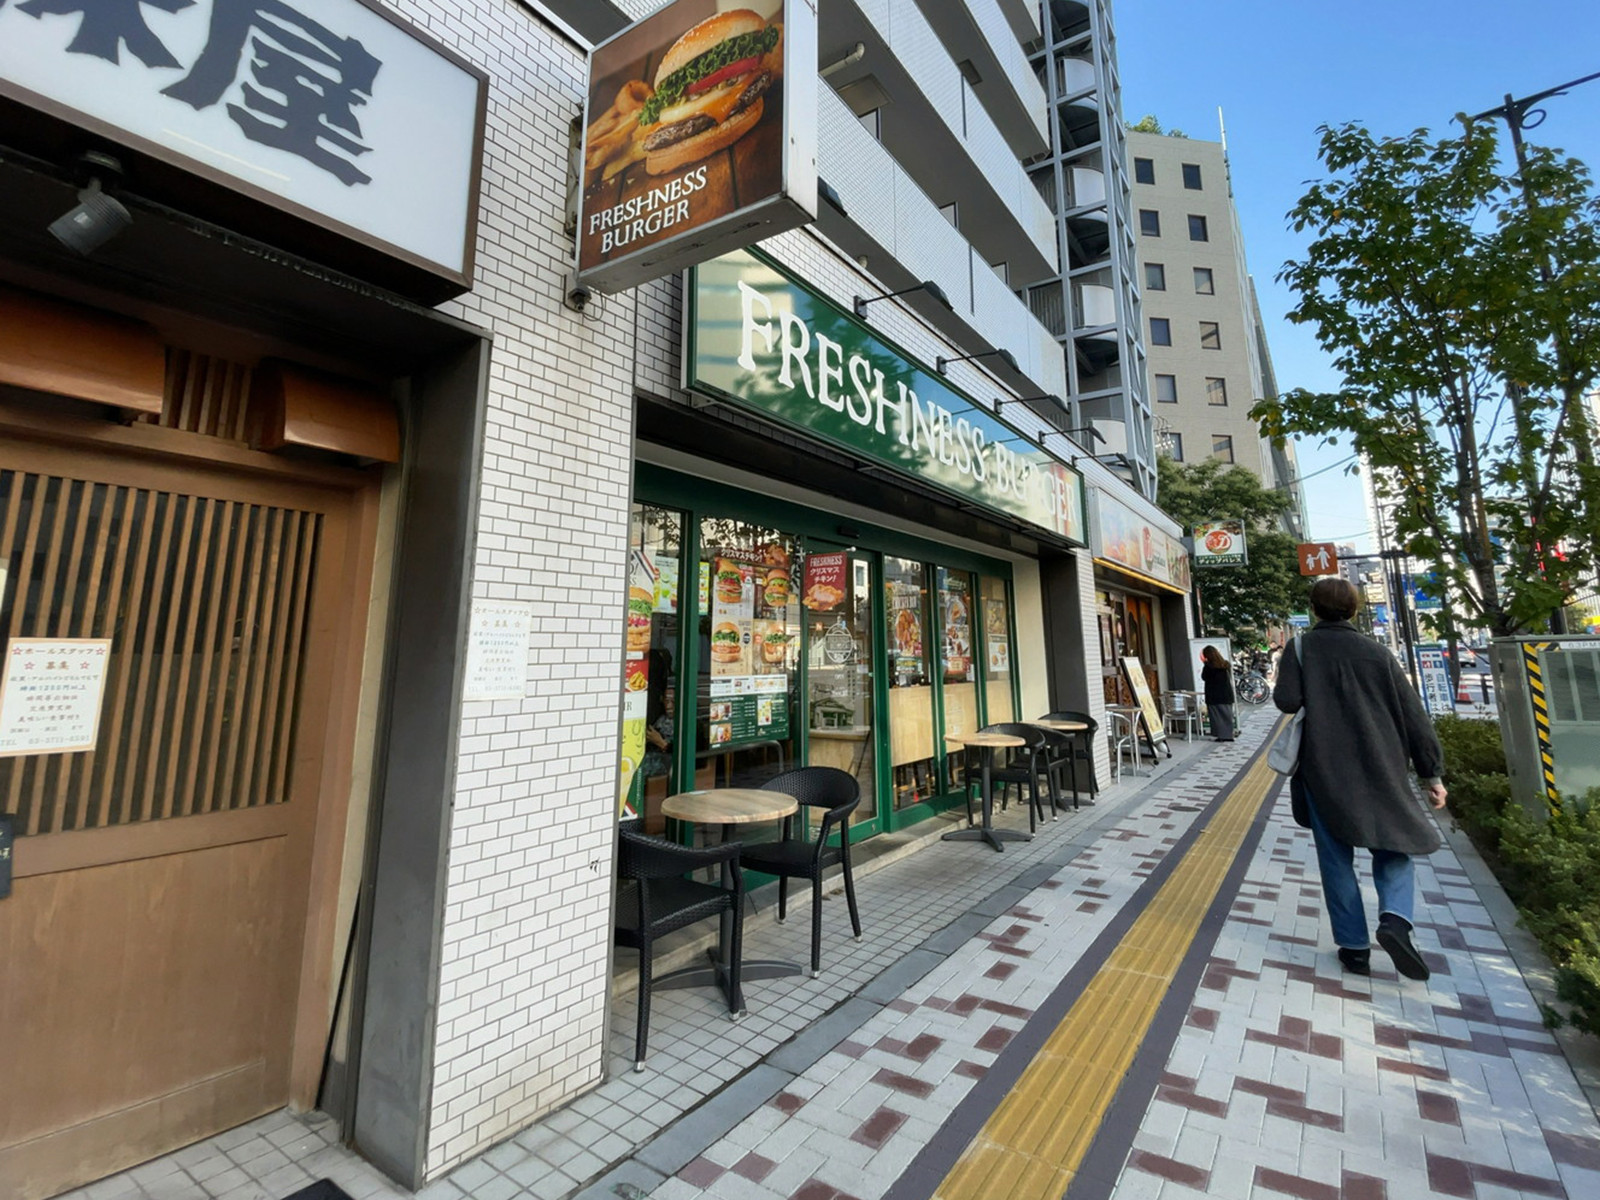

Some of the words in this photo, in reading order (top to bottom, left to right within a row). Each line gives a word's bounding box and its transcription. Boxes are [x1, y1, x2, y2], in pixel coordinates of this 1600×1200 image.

[589, 165, 707, 235] FRESHNESS
[600, 199, 690, 254] BURGER
[737, 280, 986, 483] FRESHNESS
[994, 440, 1078, 529] BURGER
[810, 566, 840, 576] クリスマス
